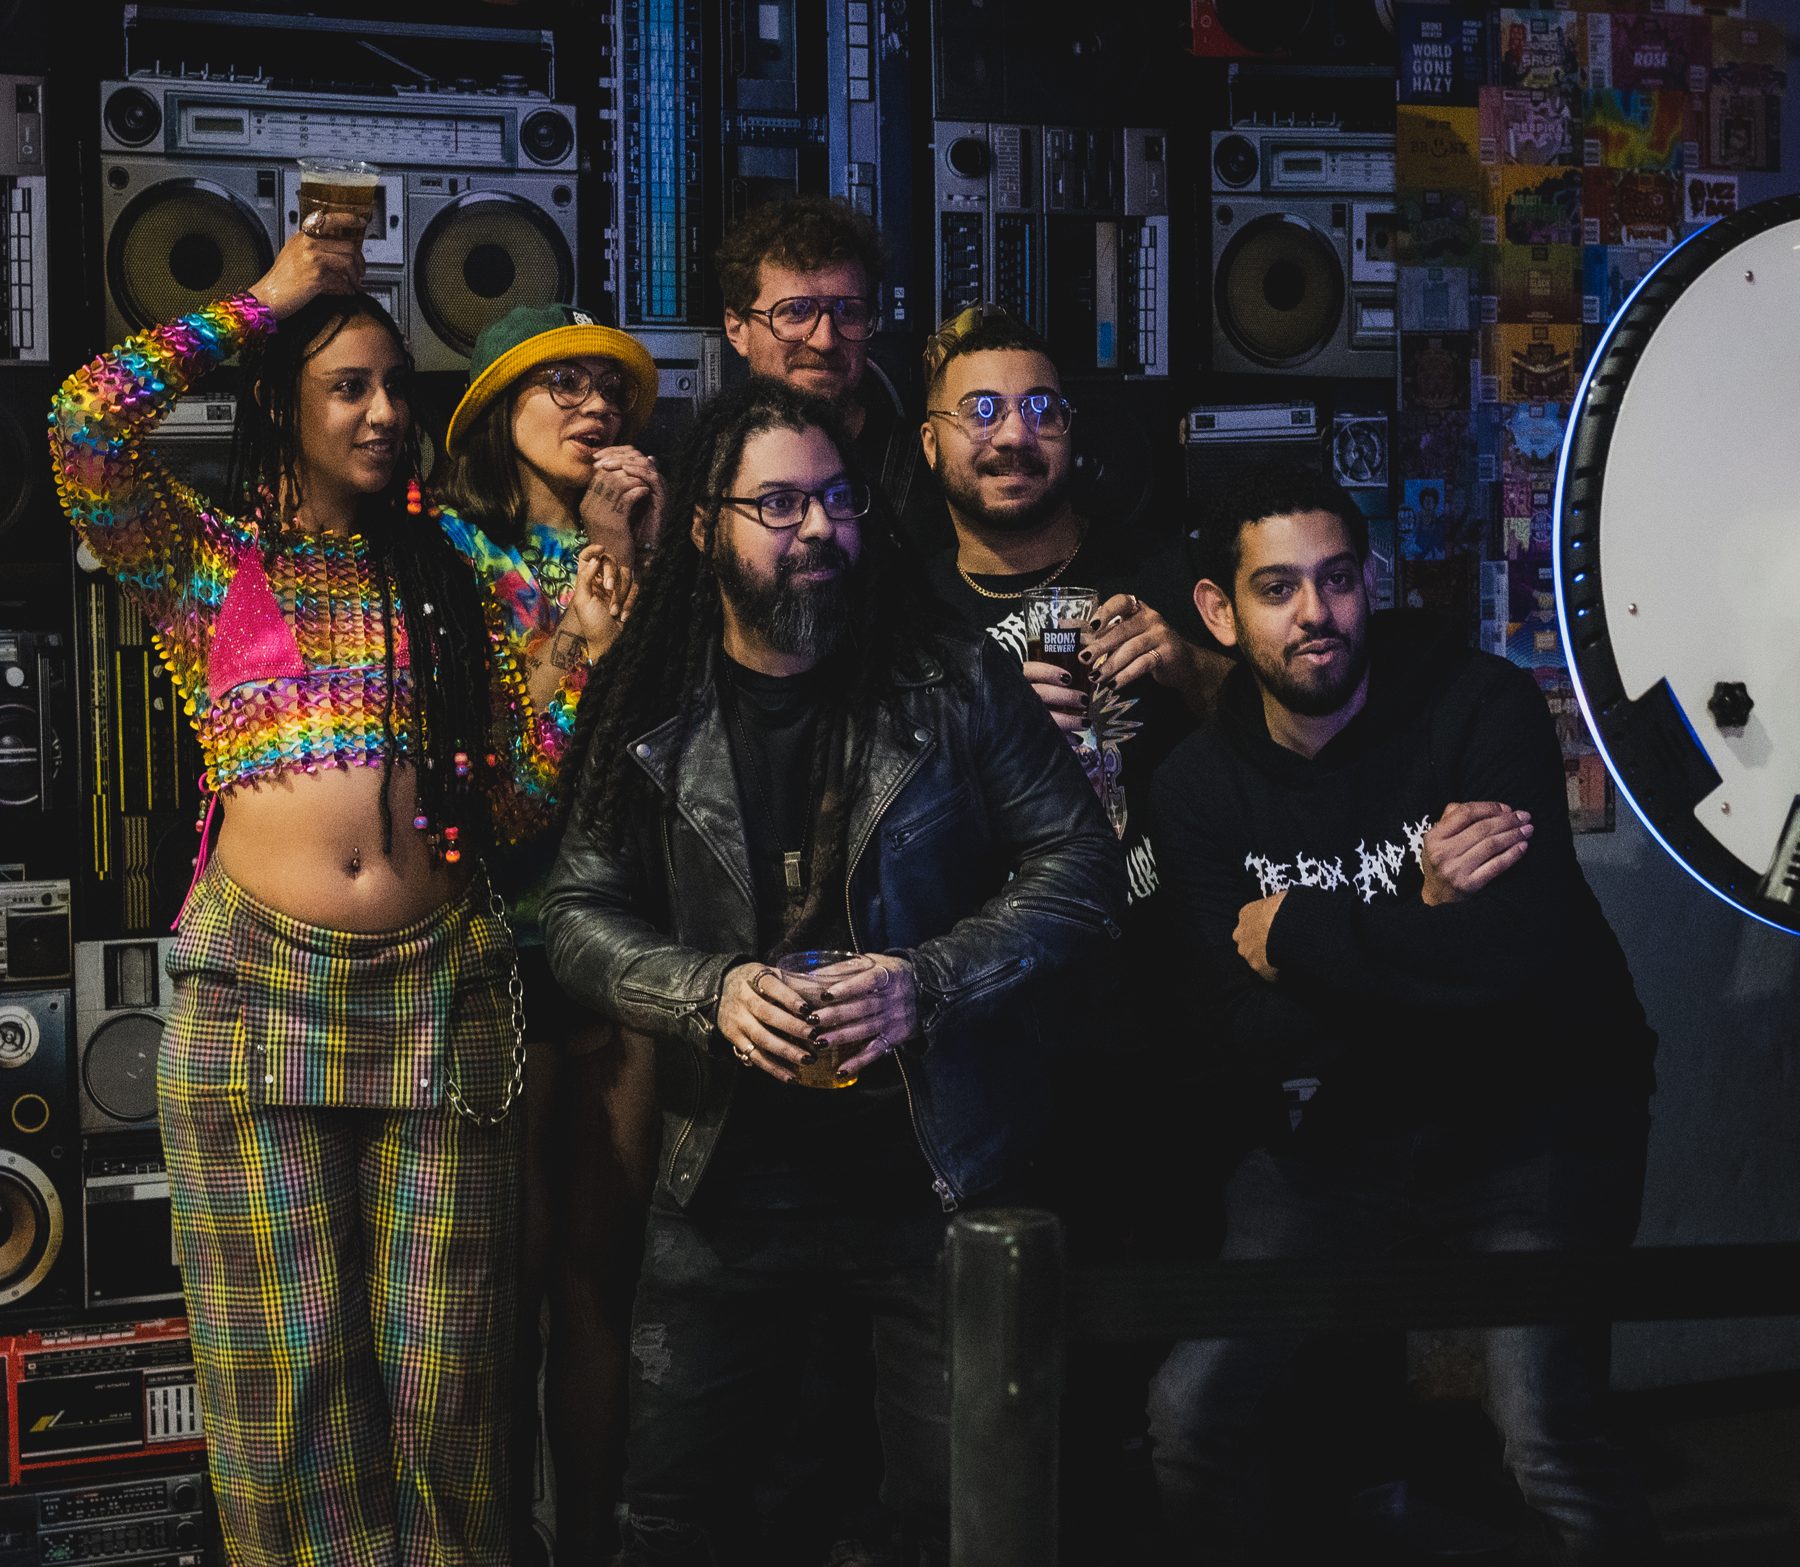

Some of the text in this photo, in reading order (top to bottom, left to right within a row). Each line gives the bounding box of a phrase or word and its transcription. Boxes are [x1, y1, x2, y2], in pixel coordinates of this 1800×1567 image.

[1412, 44, 1452, 58] WORLD
[1412, 60, 1452, 75] GONE
[1412, 77, 1452, 92] HAZY
[1044, 632, 1076, 644] BRONX
[1044, 644, 1076, 653] BREWERY
